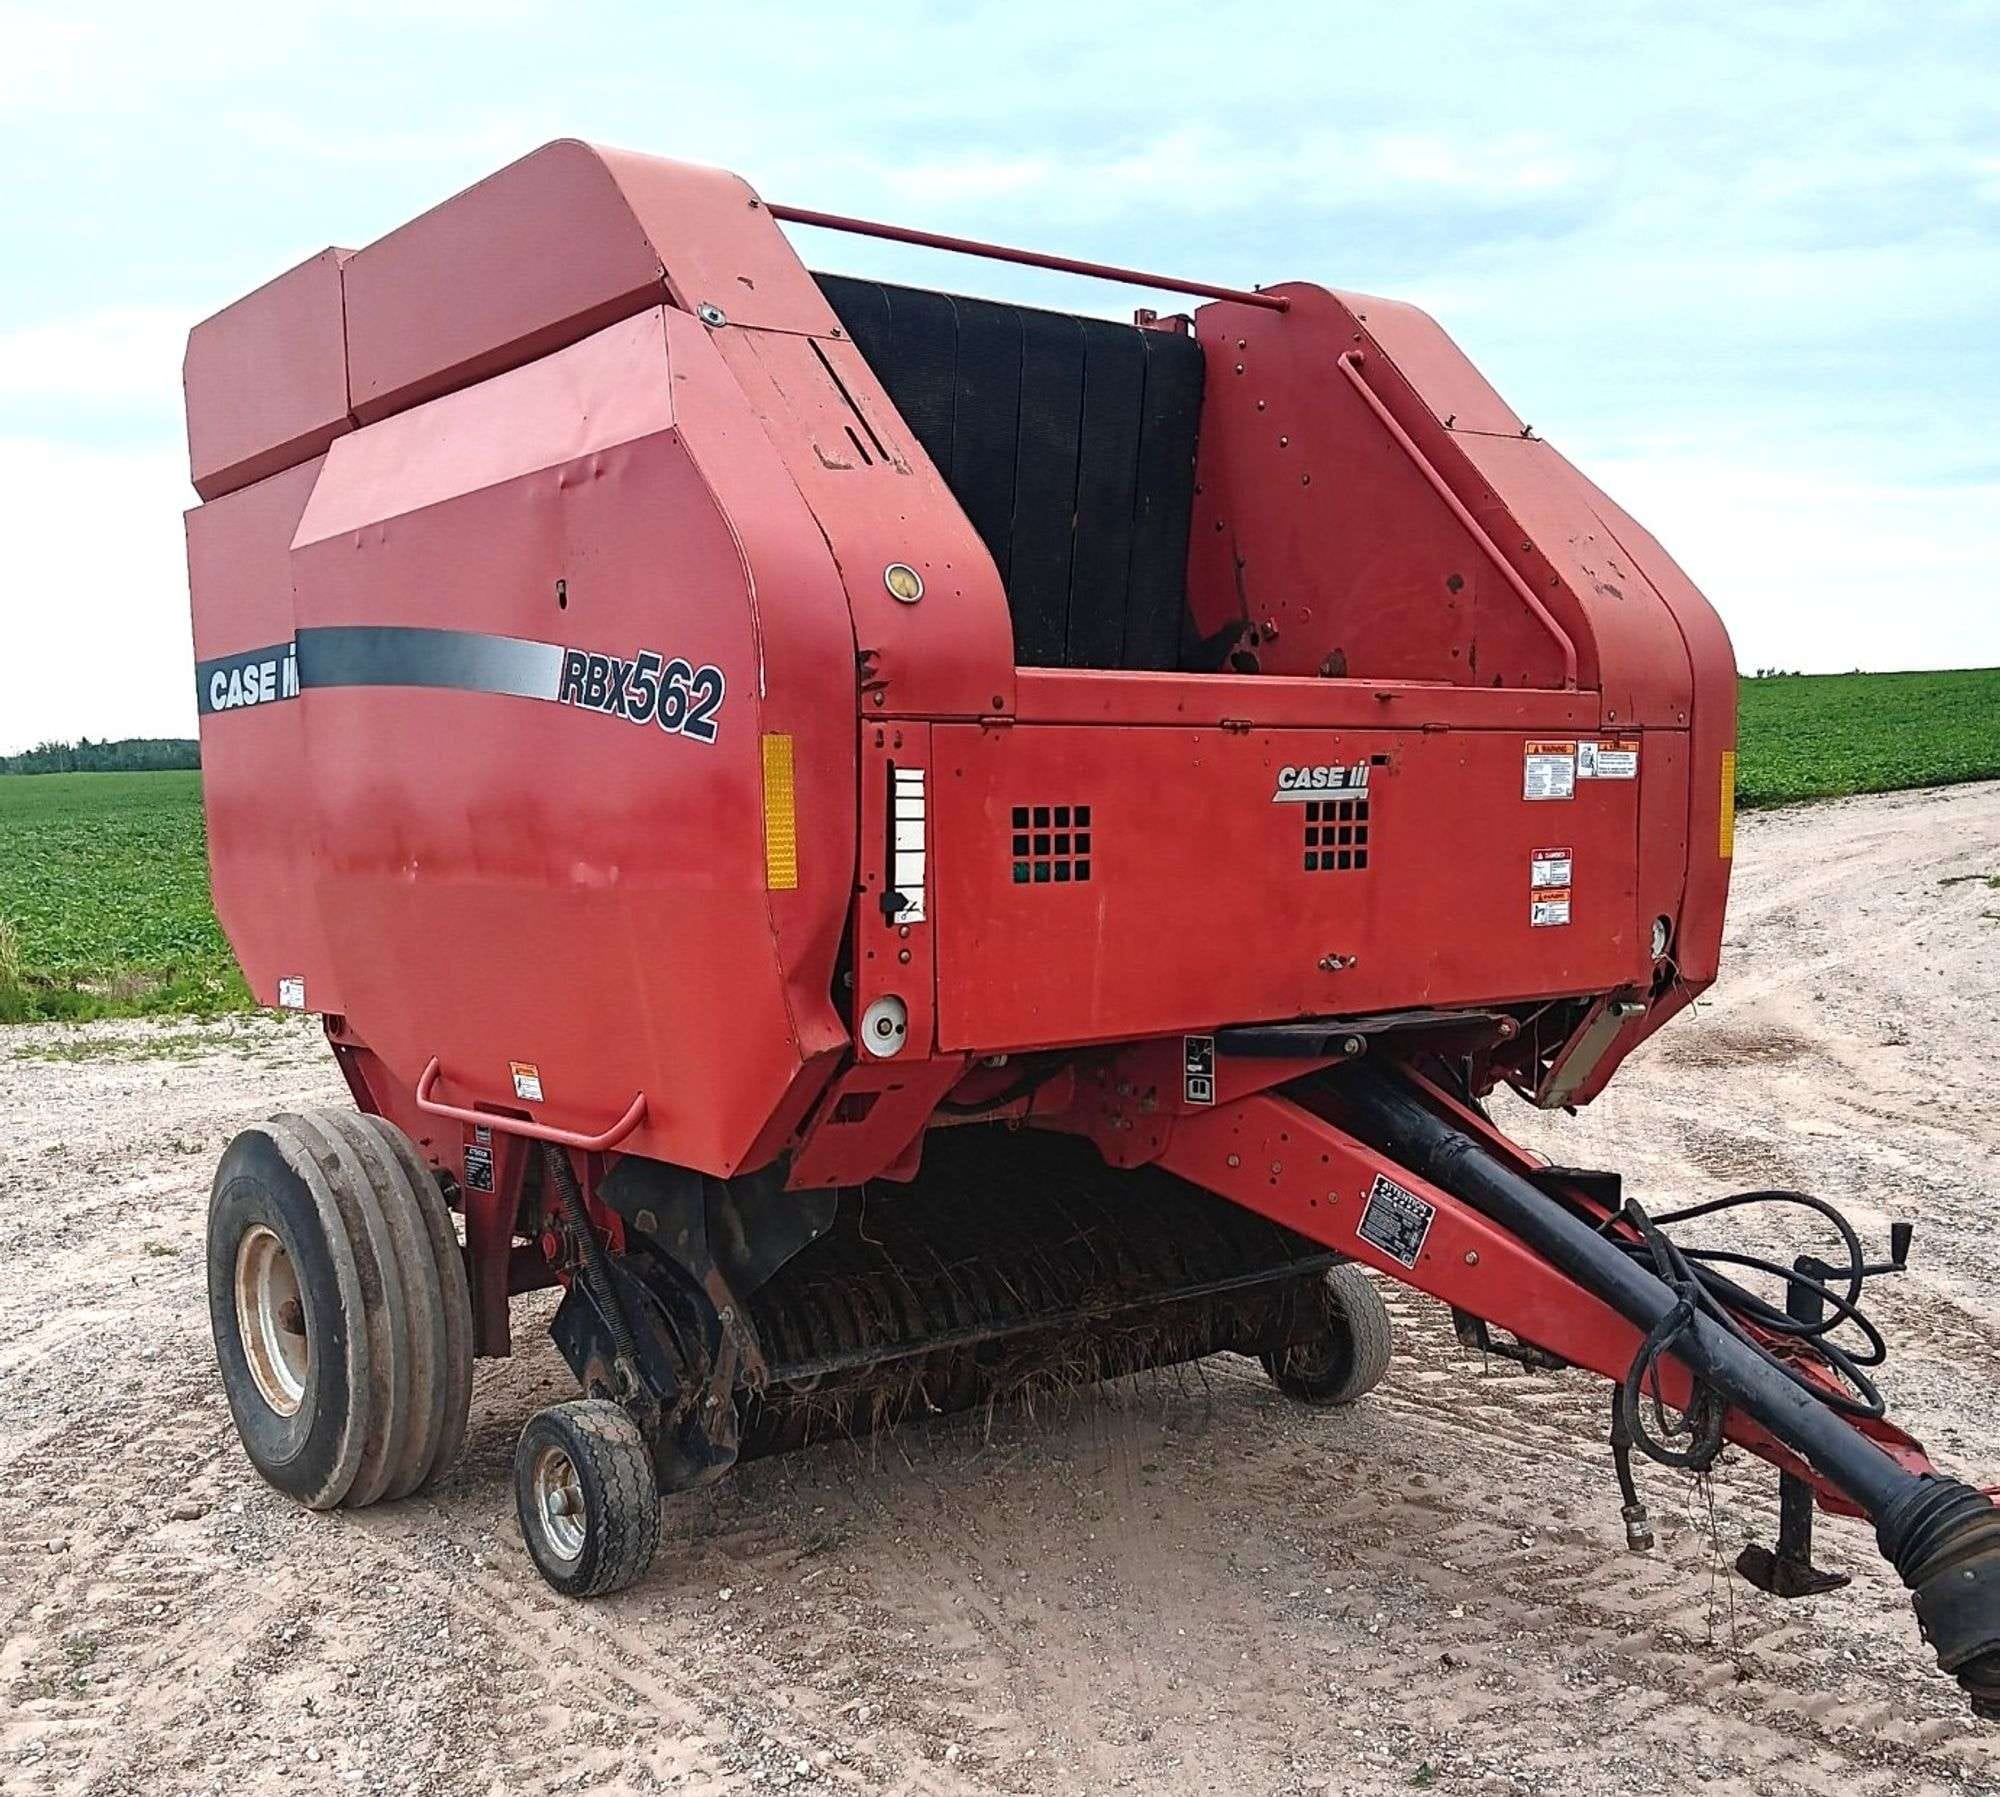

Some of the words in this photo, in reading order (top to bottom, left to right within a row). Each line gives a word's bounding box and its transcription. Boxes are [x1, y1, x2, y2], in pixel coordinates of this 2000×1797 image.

[210, 661, 276, 711] CASE
[560, 649, 726, 744] RBX562
[1278, 766, 1345, 789] CASE
